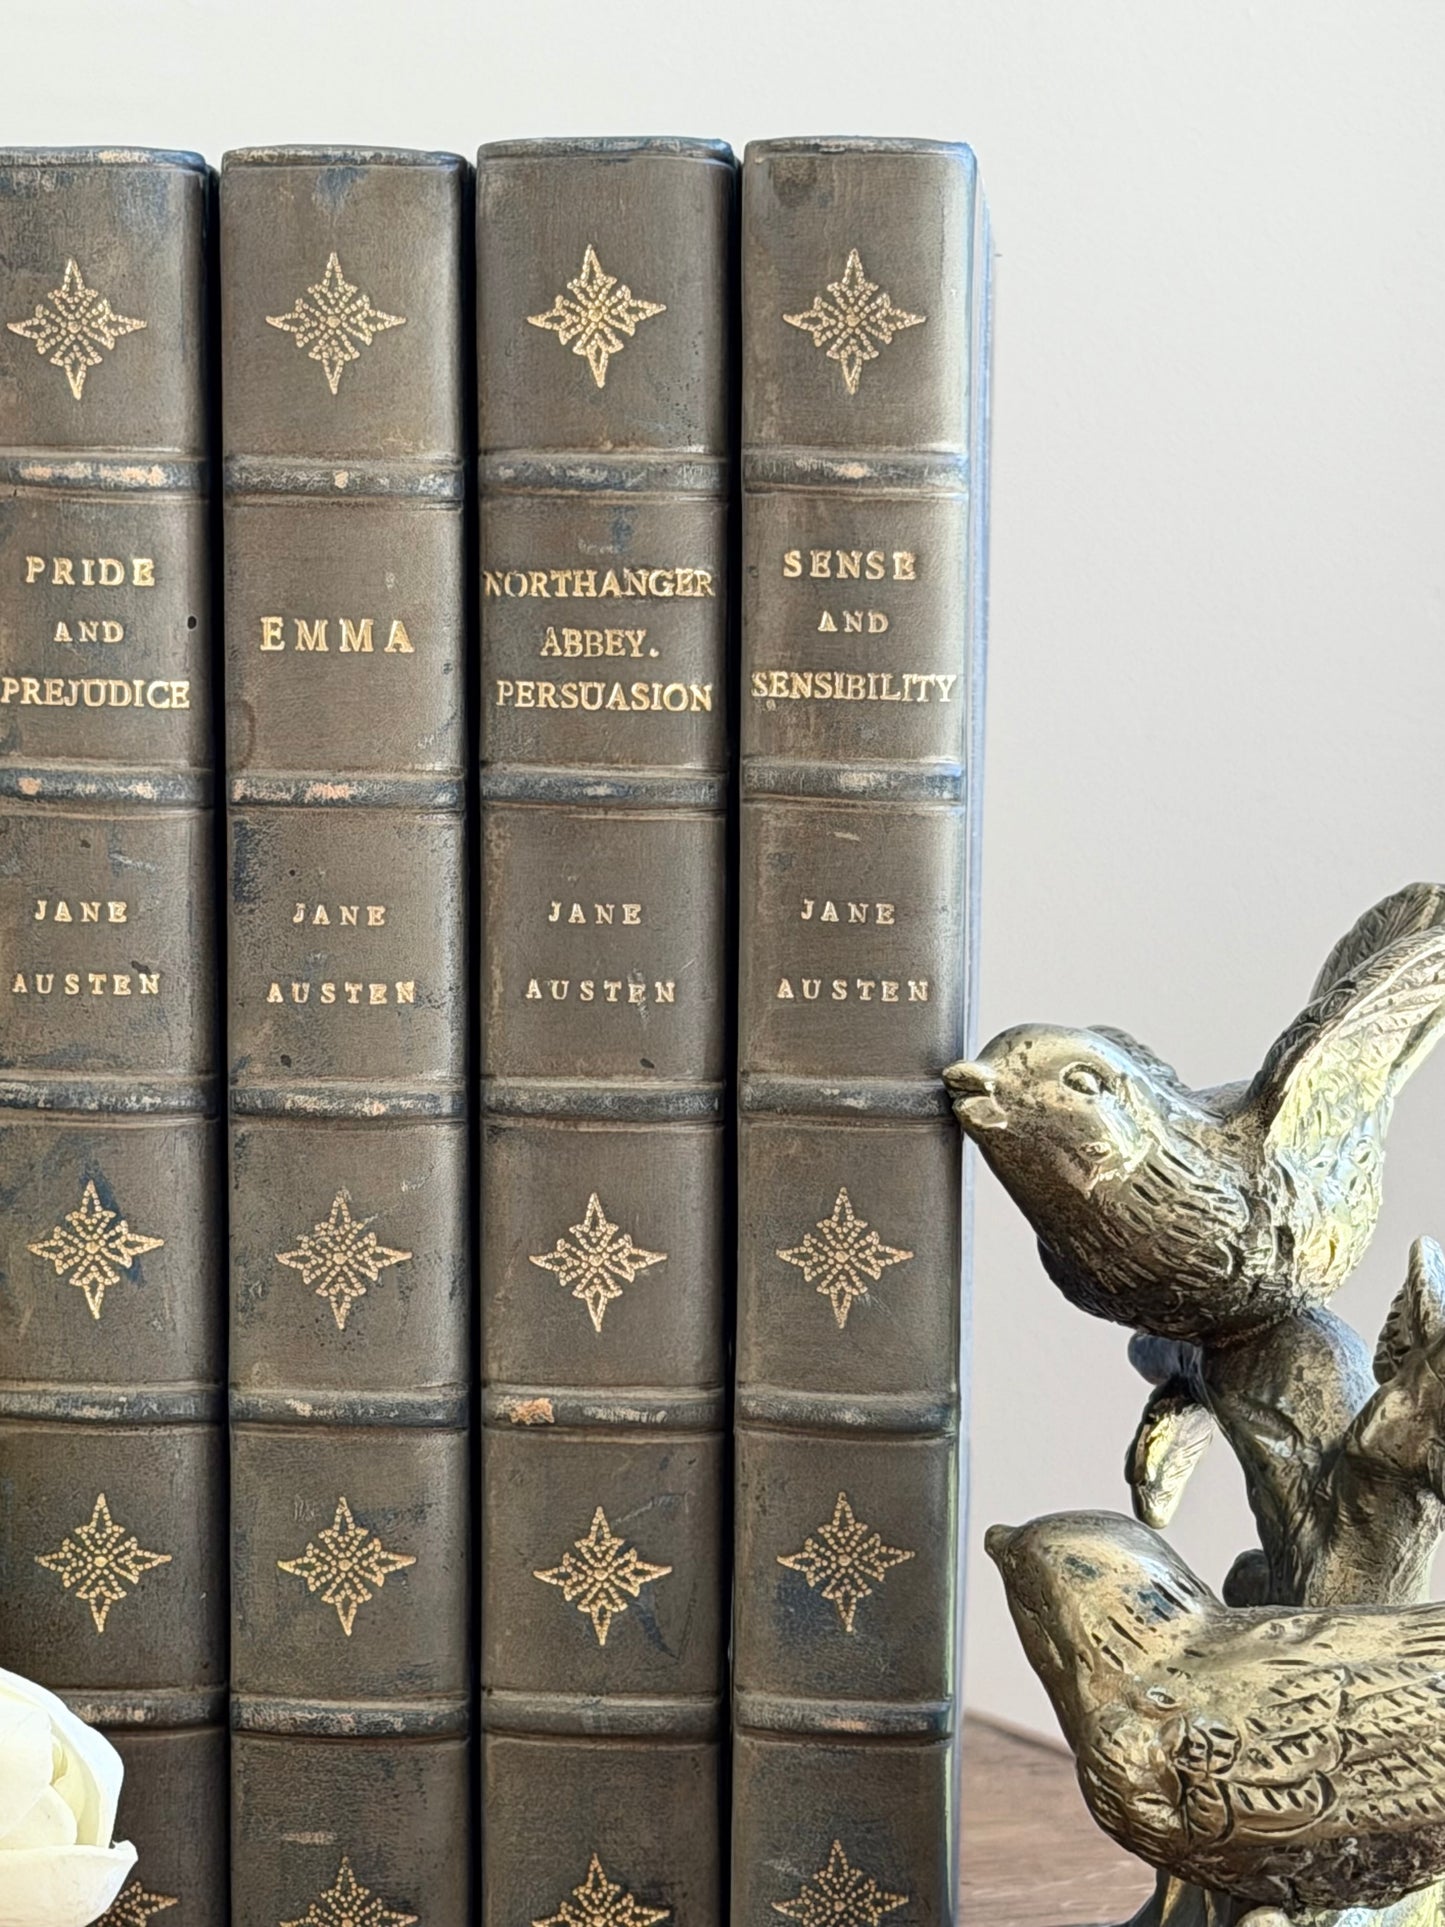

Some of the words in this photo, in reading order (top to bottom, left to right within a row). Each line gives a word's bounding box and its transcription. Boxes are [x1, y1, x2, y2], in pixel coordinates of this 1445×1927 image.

[25, 555, 155, 586] PRIDE
[783, 549, 915, 580] SENSE
[483, 568, 716, 598] NORTHANGER
[54, 621, 124, 643] AND
[817, 610, 889, 633] AND
[260, 616, 414, 653] EMMA
[540, 626, 659, 657] ABBEY.
[1, 677, 190, 709] PREJUDICE
[496, 680, 713, 712] PERSUASION
[752, 671, 957, 703] SENSIBILITY
[35, 900, 128, 923] JANE
[293, 903, 386, 926] JANE
[548, 901, 641, 925] JANE
[801, 899, 895, 924] JANE
[12, 973, 160, 996] AUSTEN
[267, 980, 416, 1005] AUSTEN
[526, 978, 675, 1004] AUSTEN
[777, 978, 928, 1002] AUSTEN
